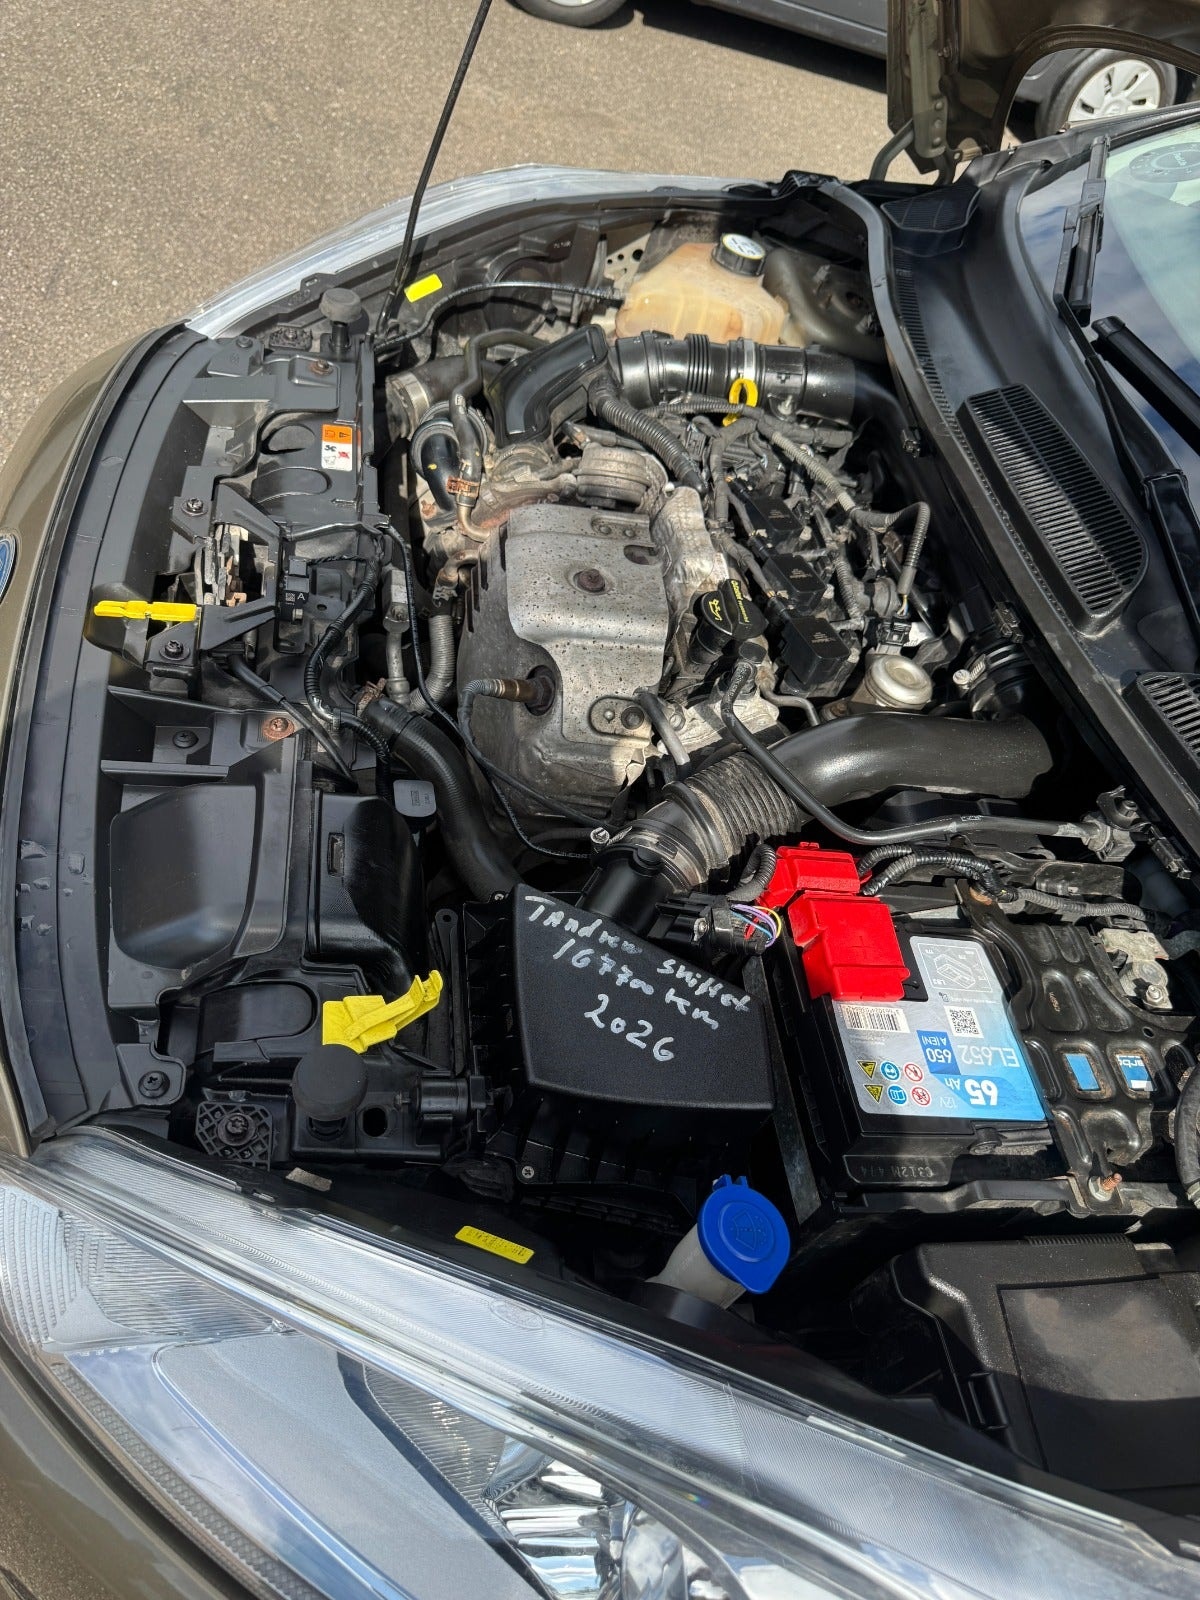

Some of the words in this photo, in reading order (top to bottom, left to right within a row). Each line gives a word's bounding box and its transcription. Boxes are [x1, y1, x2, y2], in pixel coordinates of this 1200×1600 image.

[584, 993, 674, 1062] 2026
[925, 1048, 952, 1063] 650
[957, 1044, 1020, 1068] EL652
[944, 1077, 960, 1090] Ah
[964, 1079, 998, 1106] 65
[939, 1096, 958, 1109] 12V
